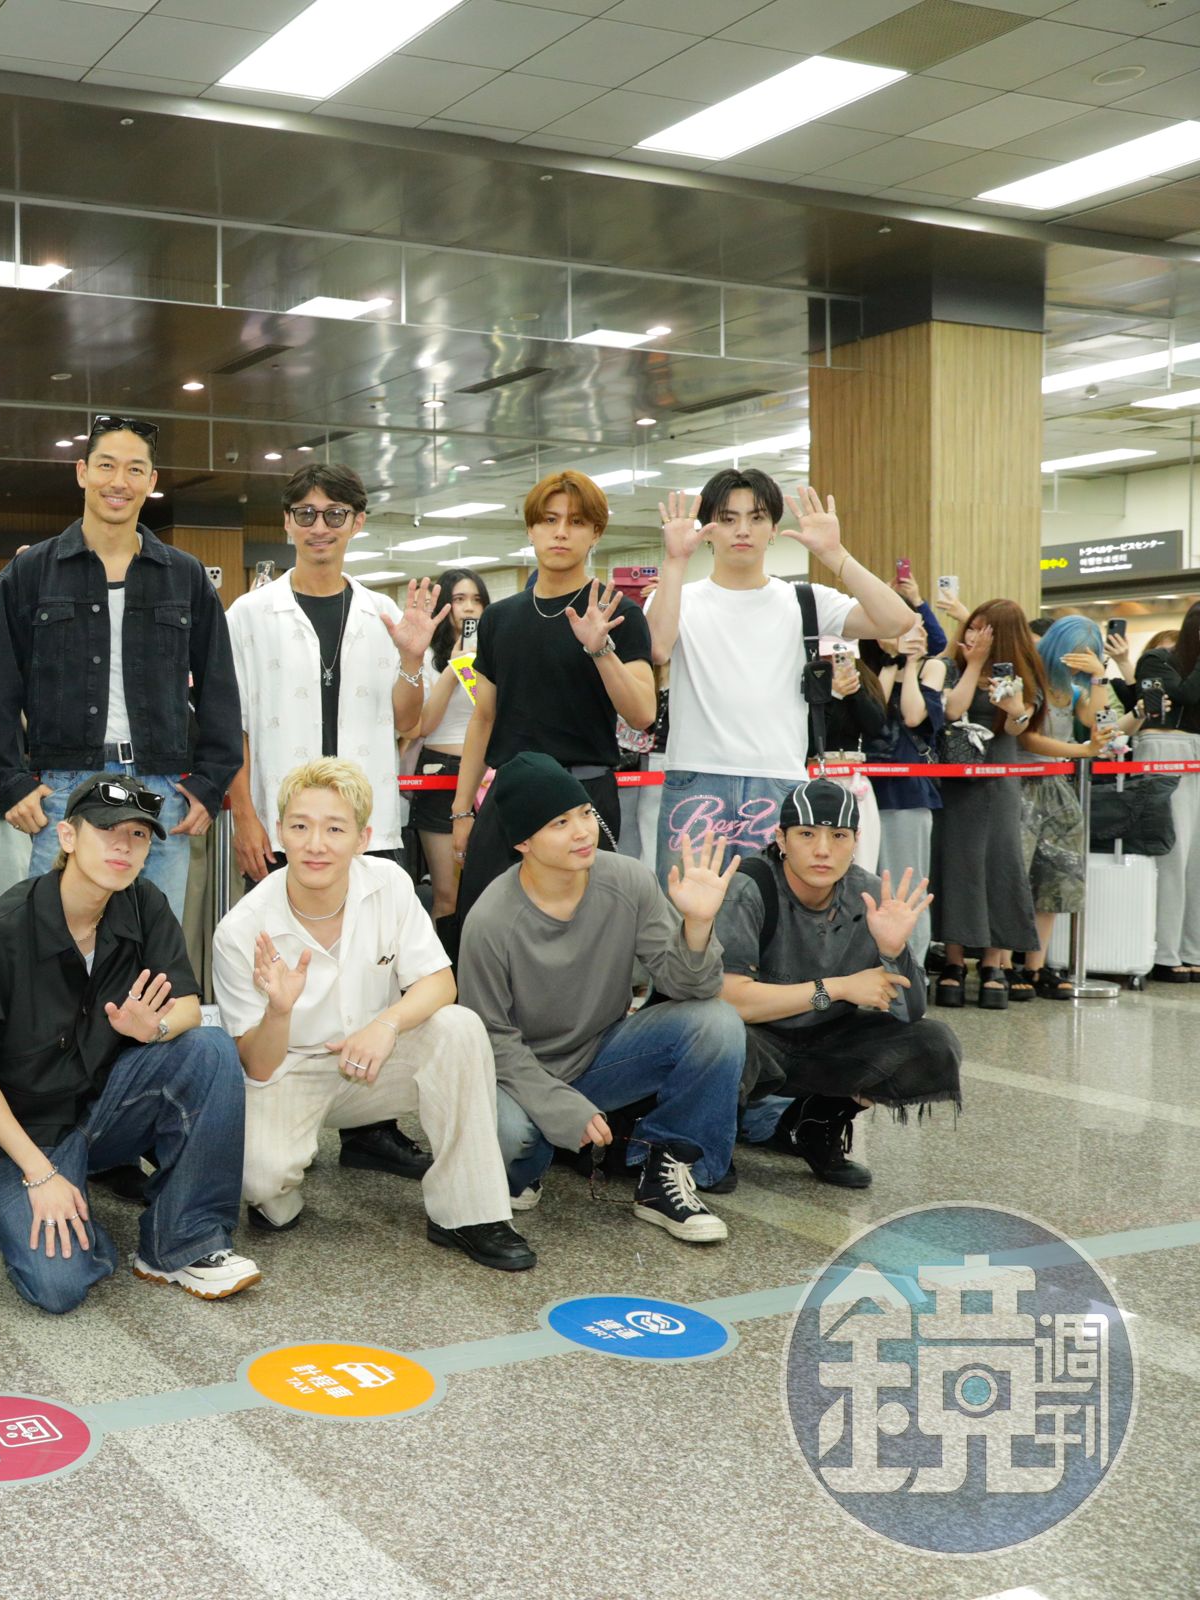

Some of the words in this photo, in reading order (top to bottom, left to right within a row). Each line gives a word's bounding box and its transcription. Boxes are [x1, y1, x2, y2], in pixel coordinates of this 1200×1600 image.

[583, 1325, 617, 1340] MRT
[286, 1376, 316, 1395] TAXI
[291, 1363, 355, 1399] 計程車
